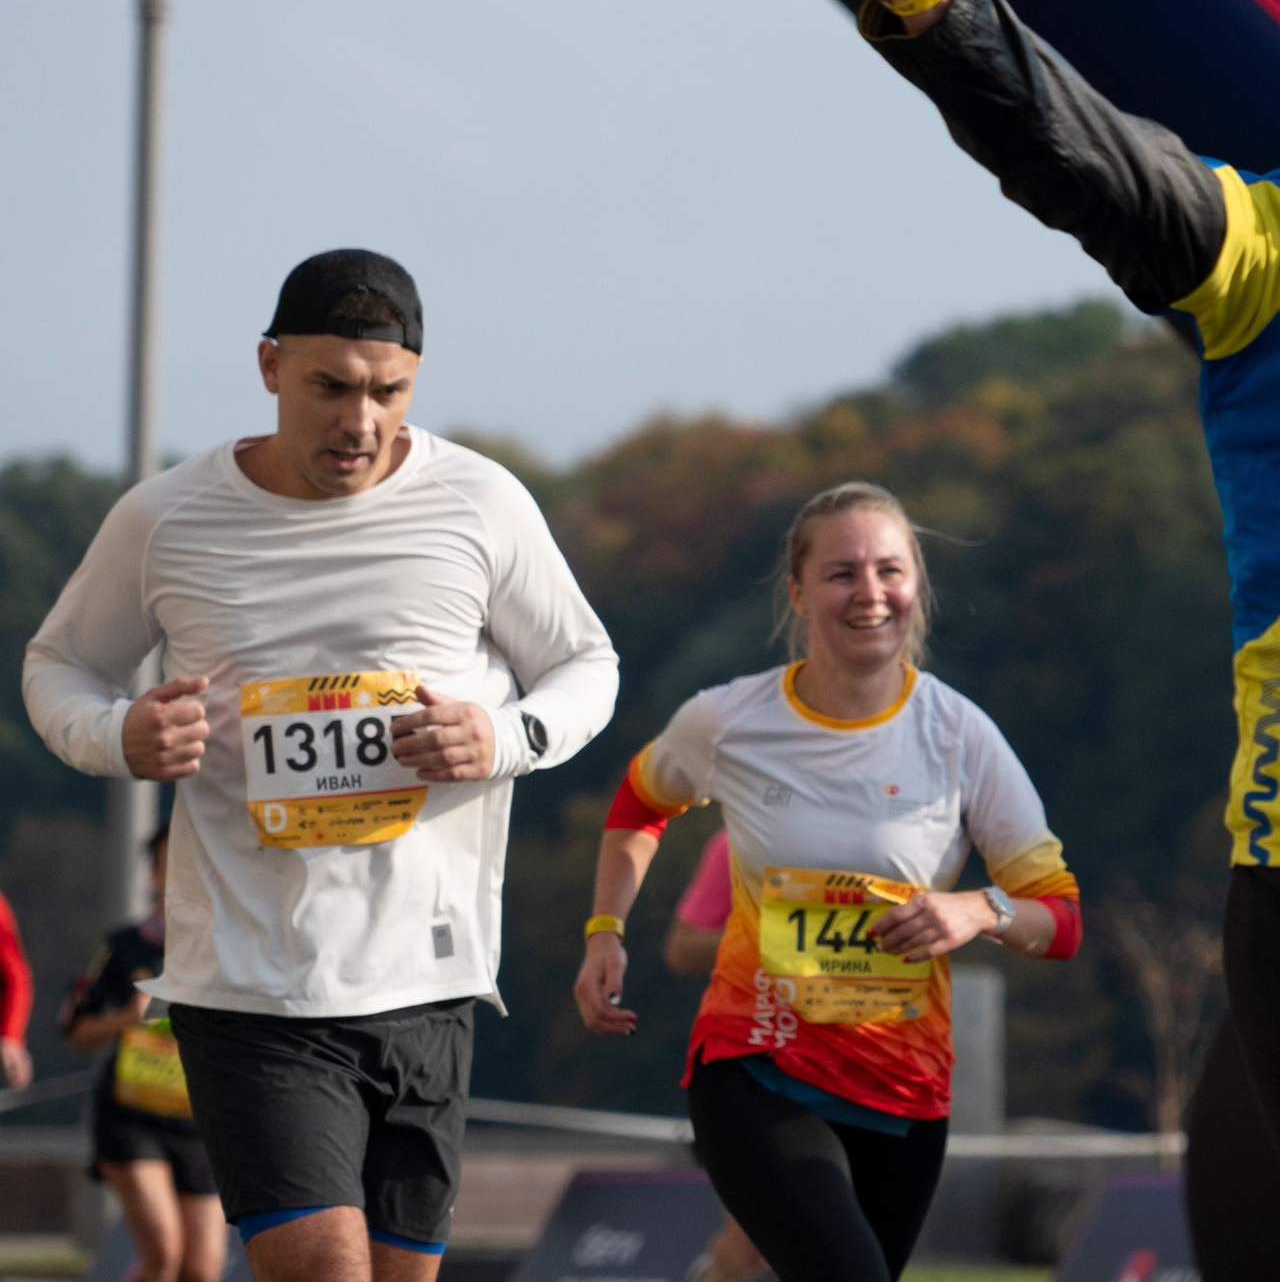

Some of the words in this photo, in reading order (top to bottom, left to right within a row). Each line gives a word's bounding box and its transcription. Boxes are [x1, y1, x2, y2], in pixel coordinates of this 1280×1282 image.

[253, 715, 417, 775] 1318
[316, 774, 362, 792] ИВАН
[788, 908, 882, 954] 144
[820, 960, 872, 974] ИРИНА
